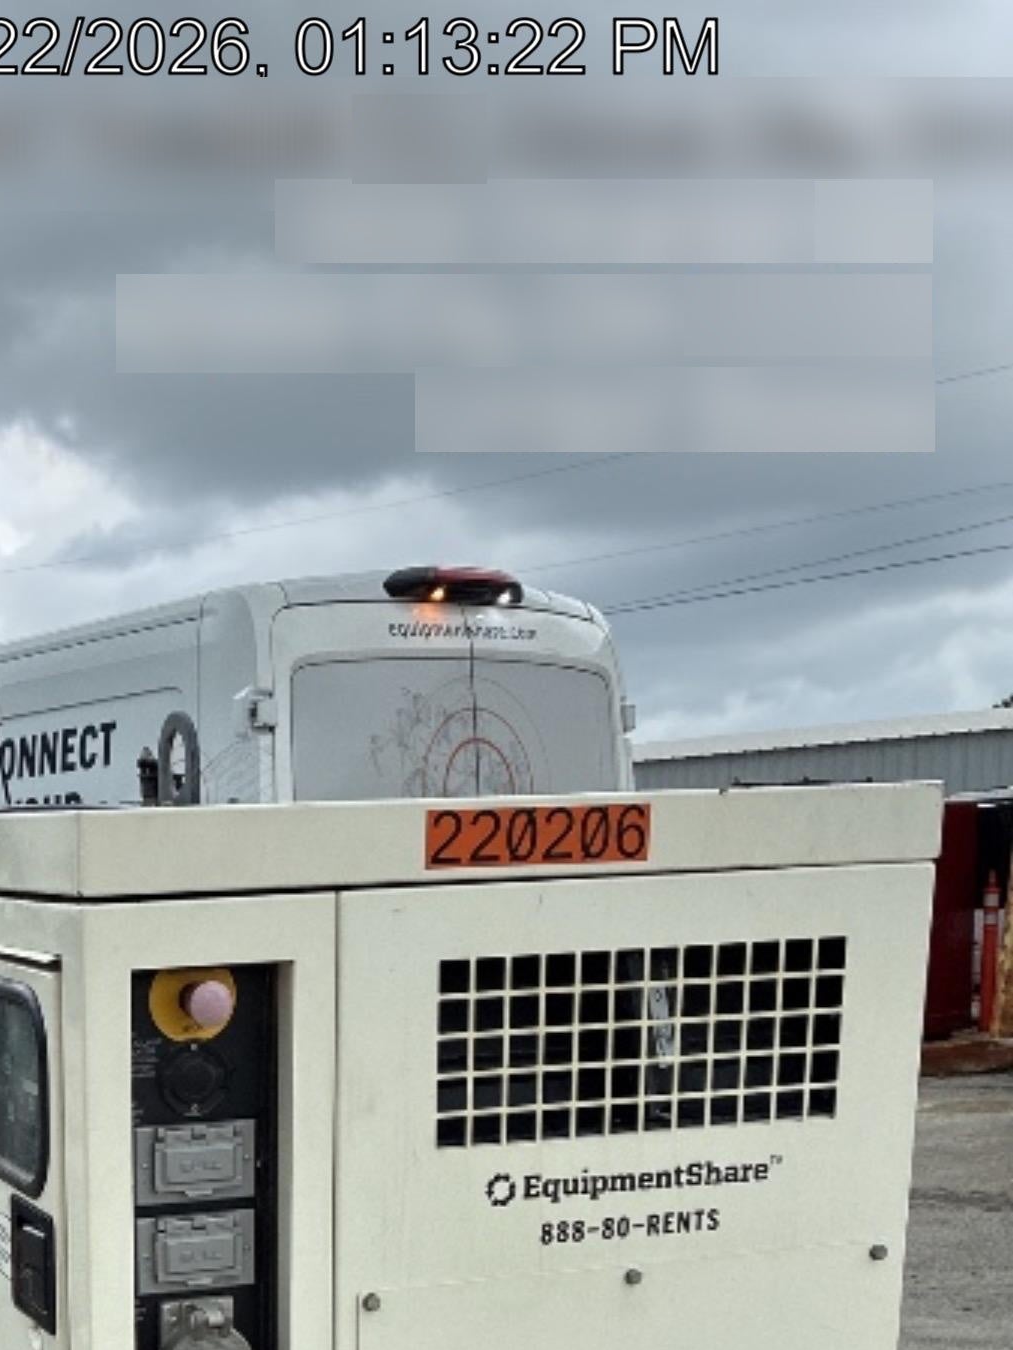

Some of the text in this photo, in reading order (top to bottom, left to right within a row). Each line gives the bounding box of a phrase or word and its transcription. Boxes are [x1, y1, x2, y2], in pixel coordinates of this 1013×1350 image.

[0, 720, 117, 780] ONNECT
[430, 803, 647, 865] 220206
[523, 1161, 770, 1204] EquipmentShare
[540, 1208, 721, 1246] 888-80-RENTS
